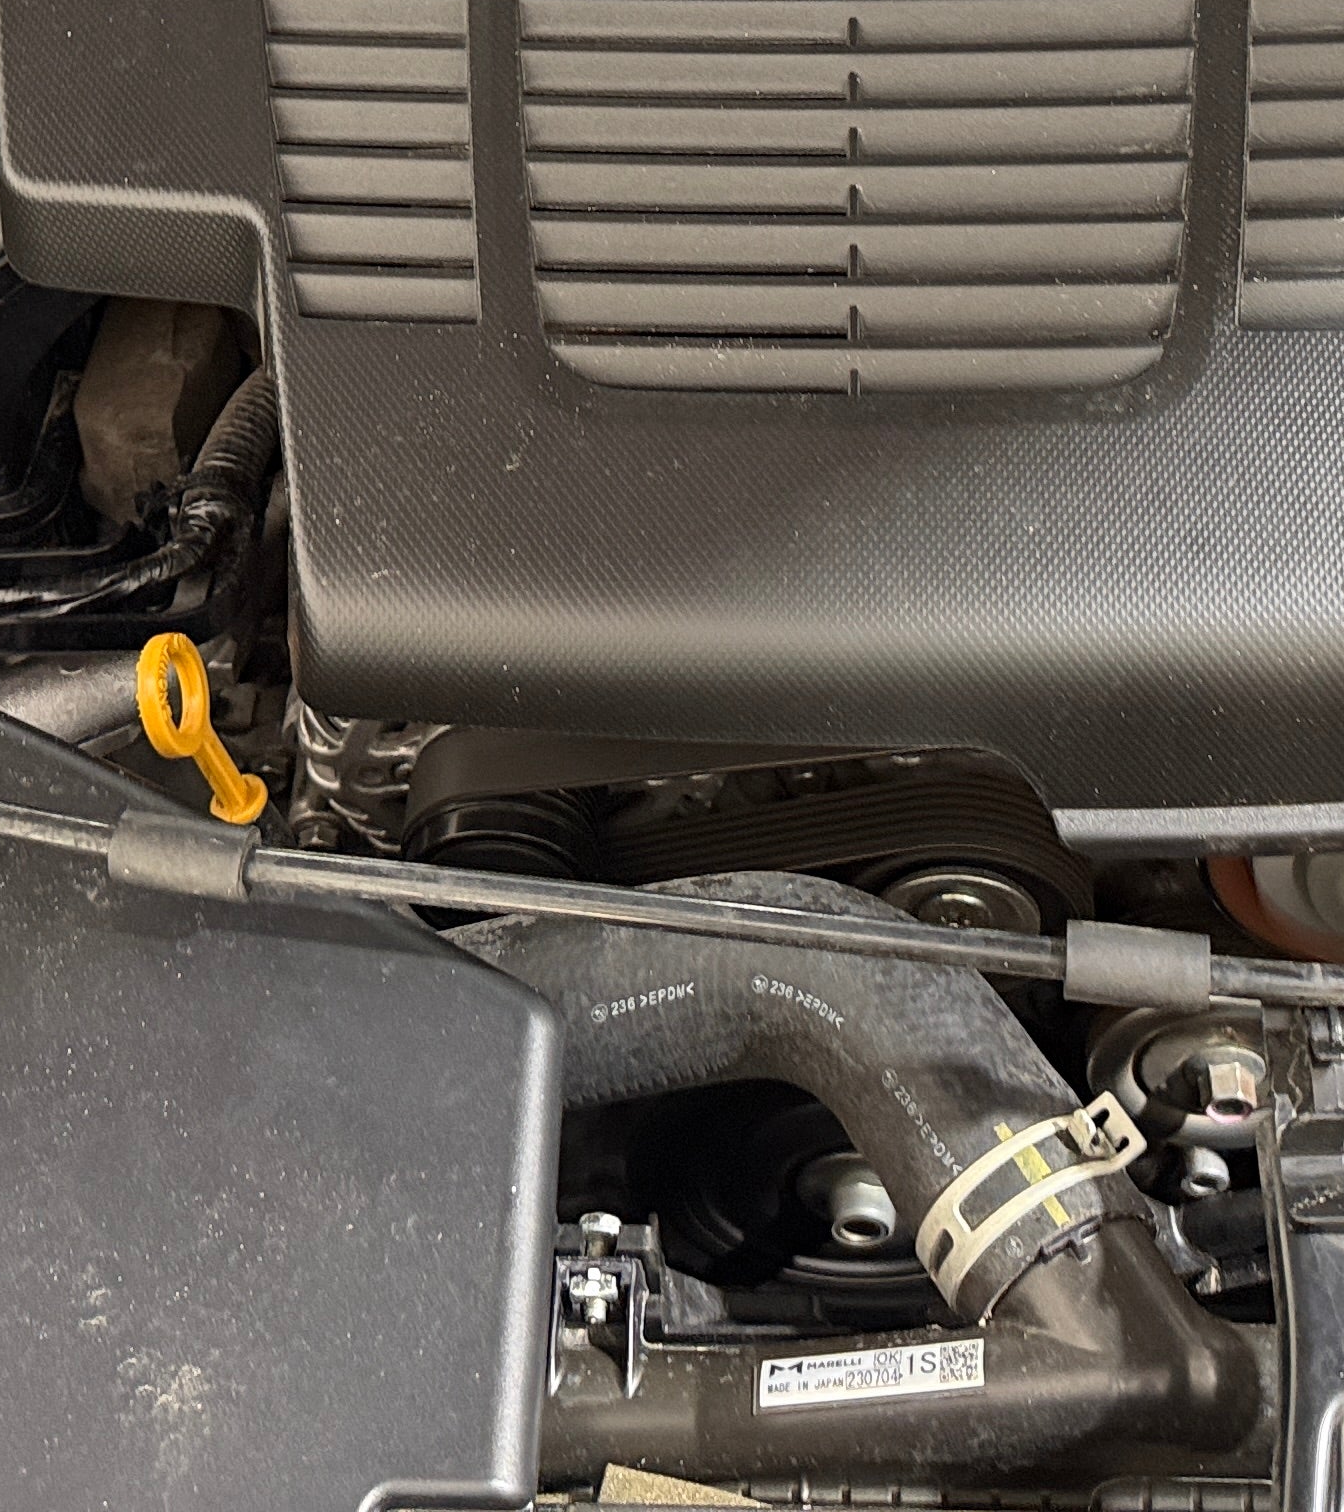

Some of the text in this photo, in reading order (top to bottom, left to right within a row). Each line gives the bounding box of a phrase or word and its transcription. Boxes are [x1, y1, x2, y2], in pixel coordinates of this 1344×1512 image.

[769, 980, 794, 1000] 236
[611, 997, 635, 1016] 236
[807, 1357, 862, 1370] MARELLI
[767, 1376, 844, 1394] MADE IN JAPAN
[847, 1368, 897, 1387] 230704
